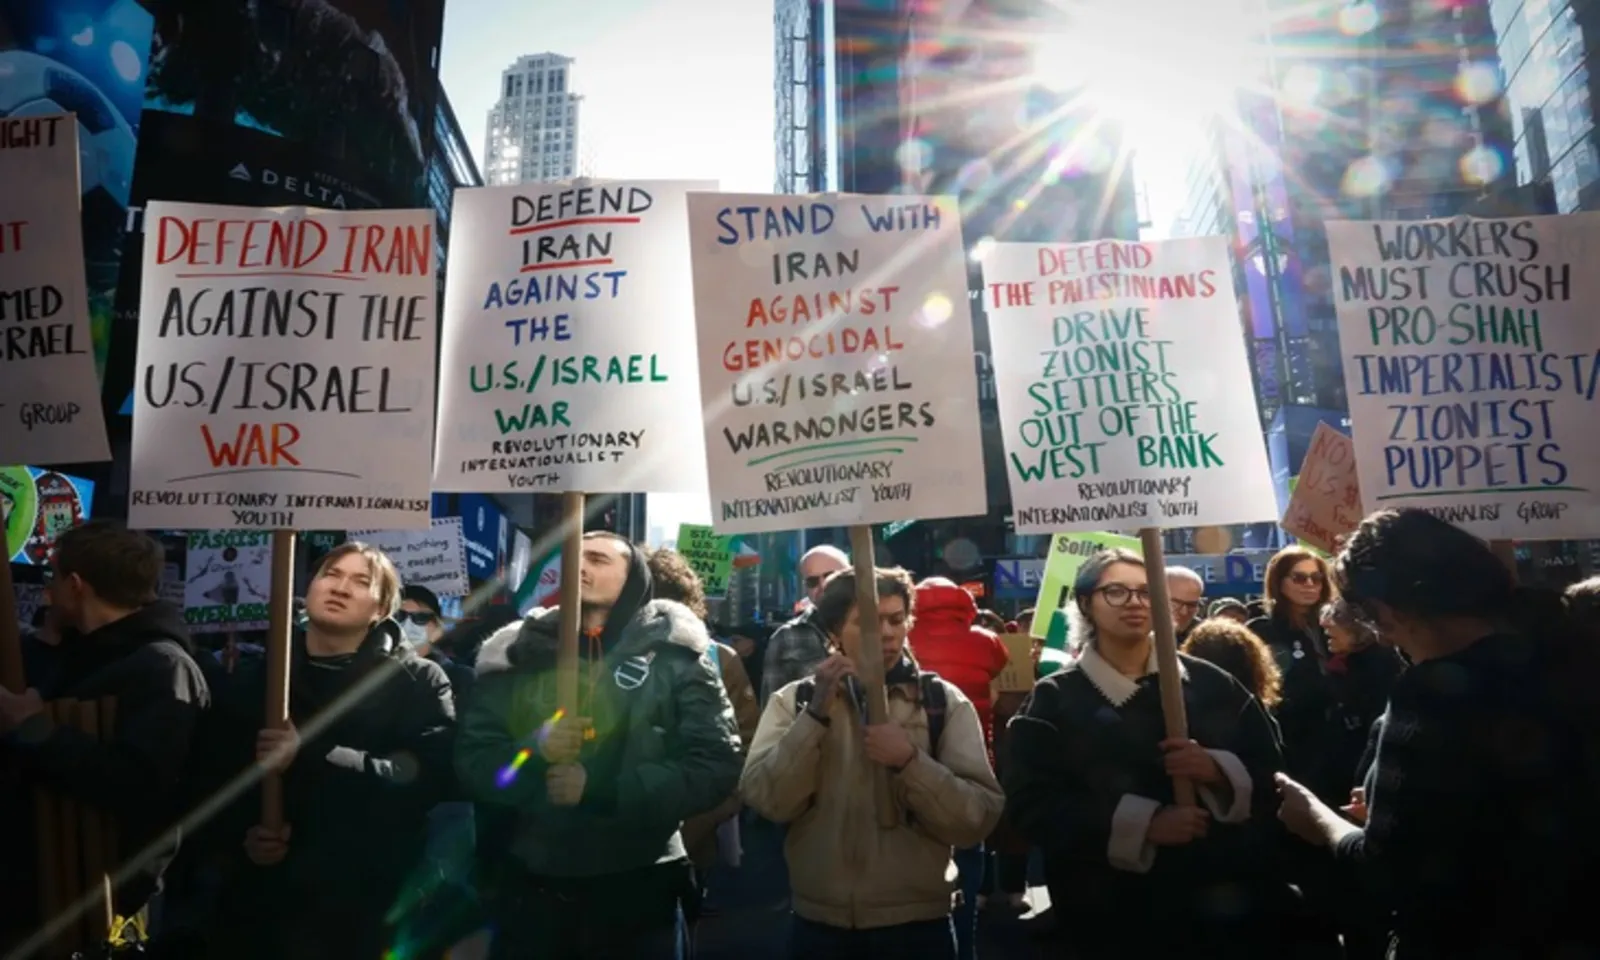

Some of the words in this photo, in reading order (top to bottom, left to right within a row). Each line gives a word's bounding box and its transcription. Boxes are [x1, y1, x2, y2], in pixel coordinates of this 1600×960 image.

[0, 115, 64, 149] IGHT
[261, 168, 347, 208] DELTA
[511, 187, 652, 226] DEFEND
[716, 203, 835, 245] STAND
[861, 204, 941, 233] WITH
[1374, 220, 1539, 262] WORKERS
[156, 216, 327, 267] DEFEND
[332, 224, 431, 275] IRAN
[522, 232, 613, 265] IRAN
[1038, 242, 1152, 276] DEFEND
[772, 249, 859, 284] IRAN
[1340, 265, 1430, 301] MUST
[1449, 262, 1570, 304] CRUSH
[483, 270, 628, 309] AGAINST
[745, 286, 899, 328] AGAINST
[989, 281, 1036, 308] THE
[1048, 270, 1217, 304] PALESTINIANS
[159, 287, 344, 339] AGAINST
[360, 294, 427, 341] THE
[505, 314, 572, 347] THE
[1053, 307, 1151, 347] DRIVE
[1368, 303, 1543, 352] PRO-SHAH
[0, 324, 86, 361] RAEL
[722, 325, 904, 371] GENOCIDAL
[1041, 341, 1173, 378] ZIONIST
[470, 353, 668, 393] U.S./ISRAEL
[731, 365, 912, 407] U.S./ISRAEL
[1354, 349, 1600, 400] IMPERIALIST/
[1027, 372, 1181, 418] SETTLERS
[20, 402, 81, 431] GROUP
[494, 401, 571, 435] WAR
[723, 402, 935, 454] WARMONGERS
[1019, 411, 1083, 448] OUT
[1098, 405, 1141, 437] OF
[1150, 402, 1198, 434] THE
[1387, 399, 1555, 441] ZIONIST
[201, 423, 300, 466] WAR
[461, 450, 624, 473] INTERNATIONALIST
[493, 430, 645, 455] REVOLUTIONARY
[1011, 442, 1108, 483] WEST
[1137, 433, 1224, 469] BANK
[507, 474, 560, 488] YOUTH
[764, 461, 893, 491] REVOLUTIONARY
[1384, 443, 1567, 489] PUPPETS
[132, 490, 278, 508] REVOLUTIONARY
[285, 493, 431, 512] INTERNATIONALIST
[721, 485, 860, 521] INTERNATIONALIST
[871, 483, 912, 502] YOUTH
[1078, 476, 1191, 500] REVOLUTIONARY
[233, 511, 294, 527] YOUTH
[1018, 501, 1149, 526] INTERNATIONALIST
[1158, 499, 1198, 517] YOUTH
[1517, 500, 1568, 524] GROUP
[189, 530, 270, 551] FASCIST
